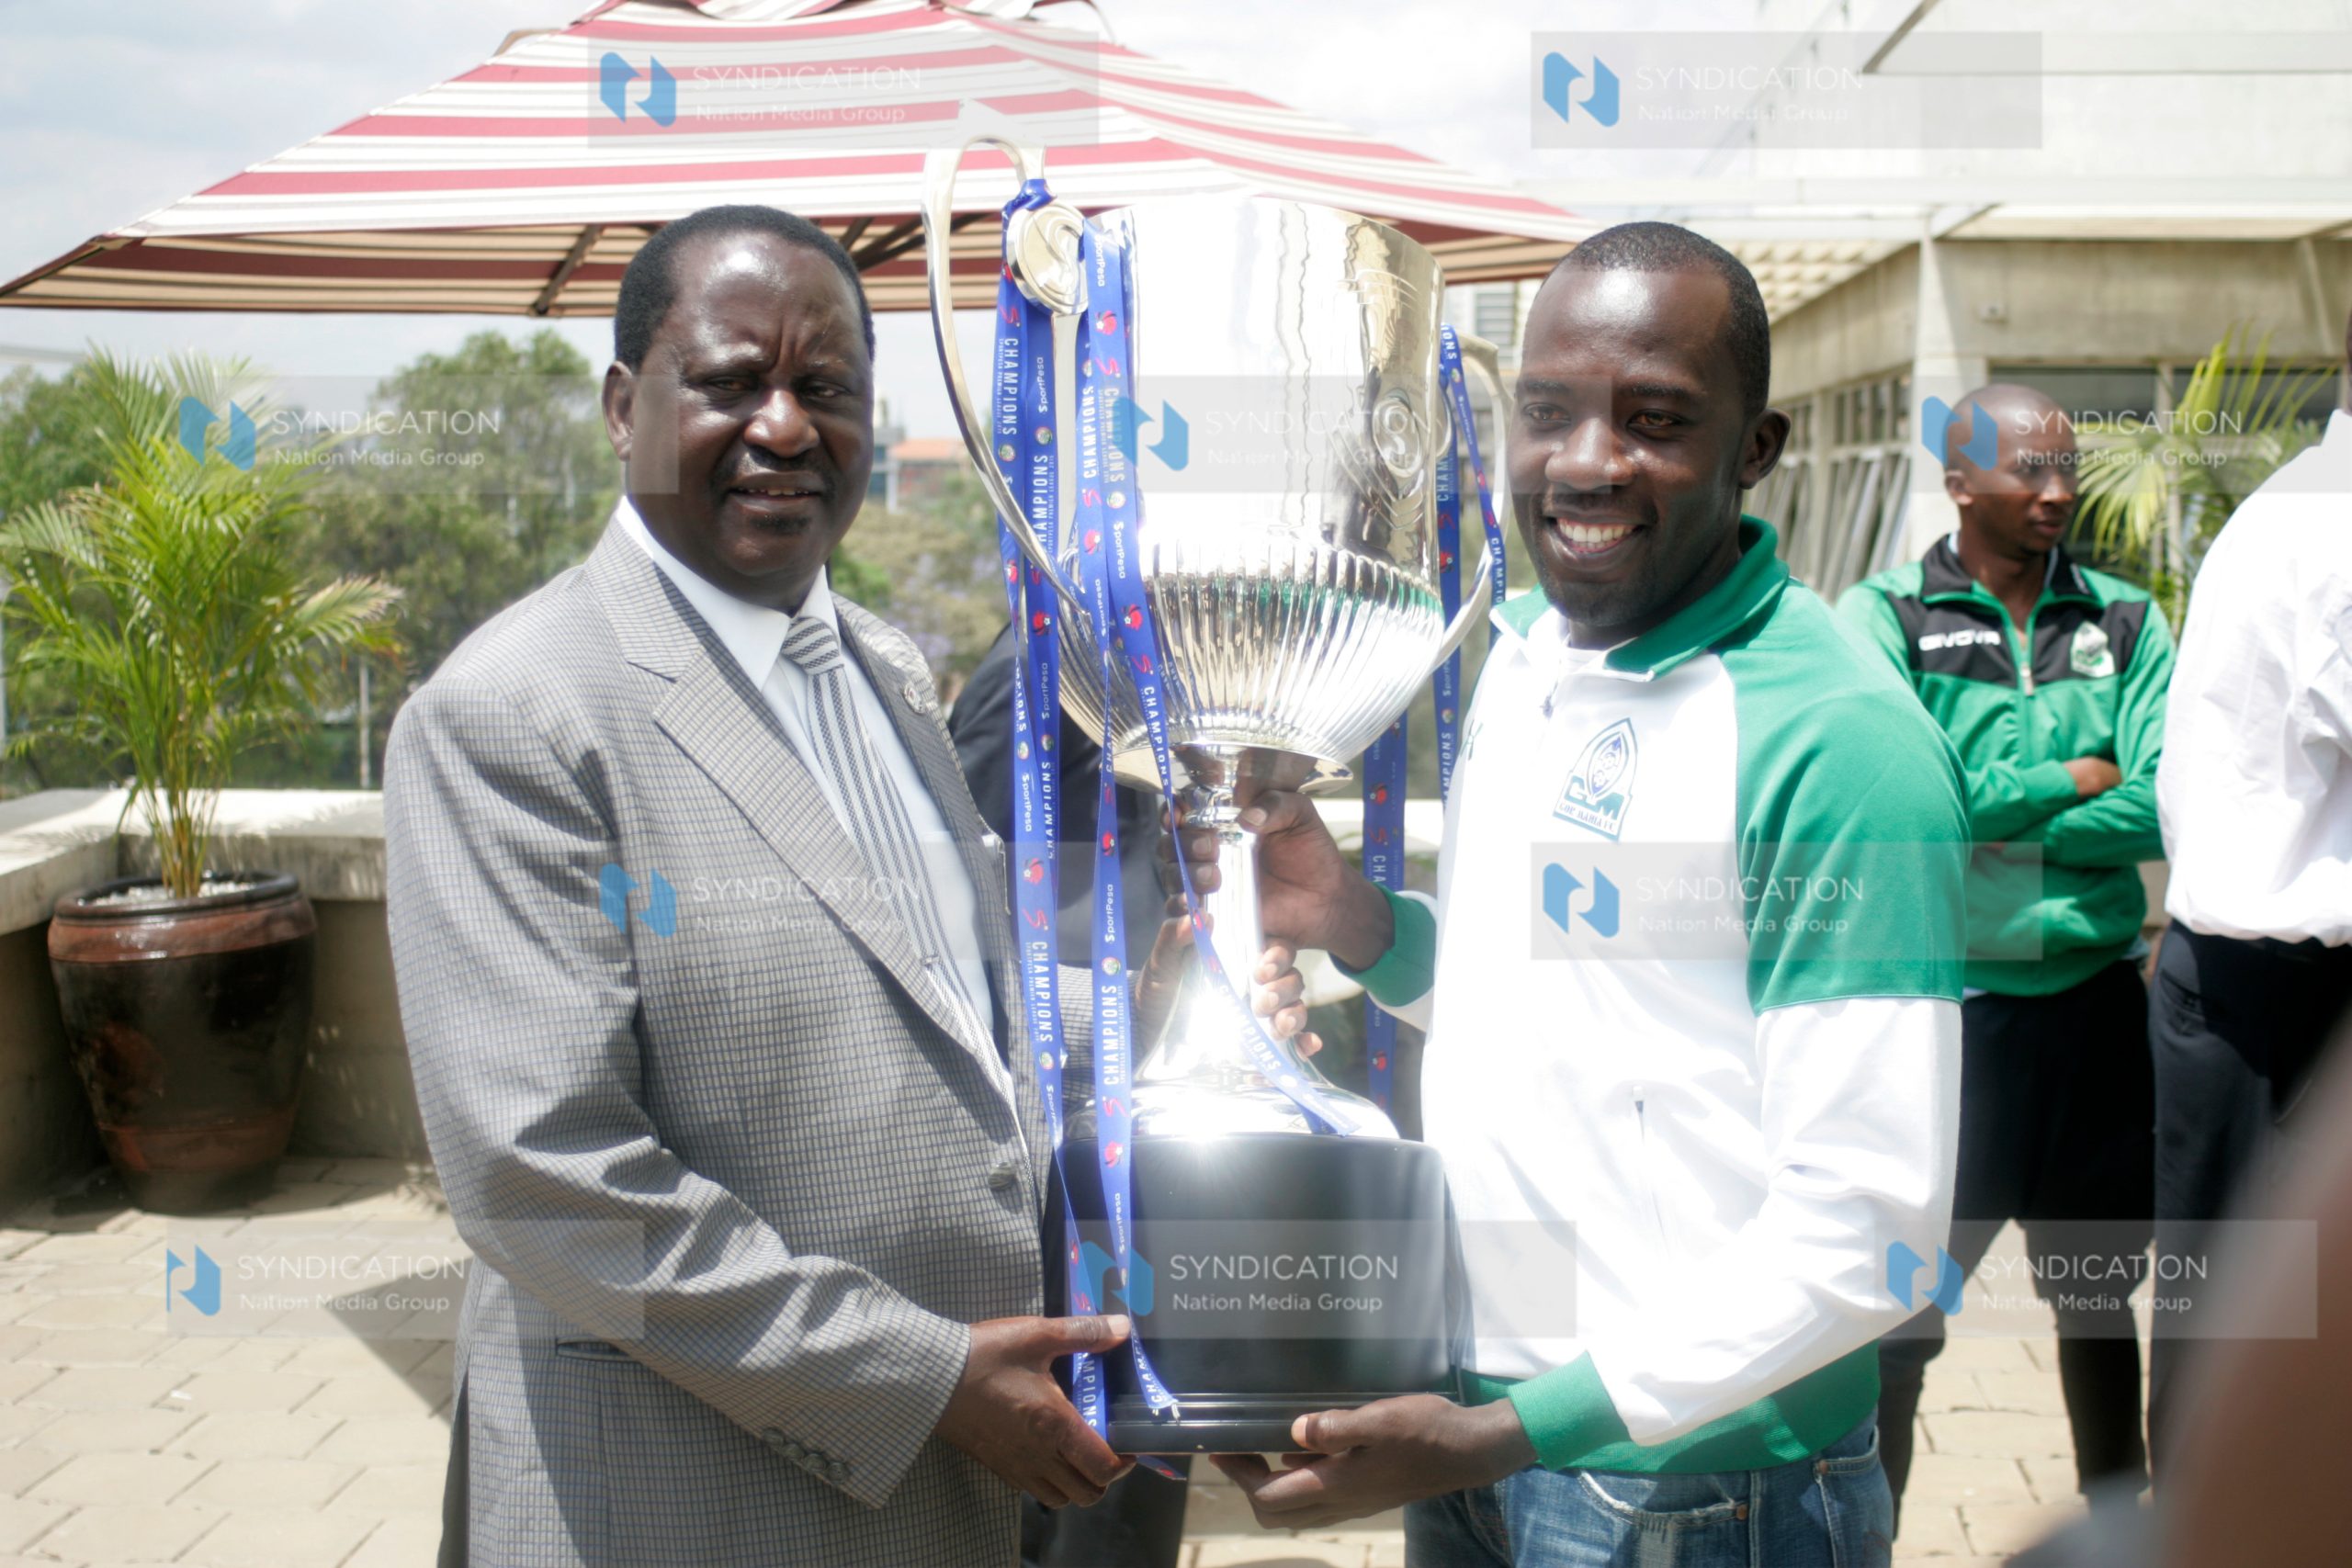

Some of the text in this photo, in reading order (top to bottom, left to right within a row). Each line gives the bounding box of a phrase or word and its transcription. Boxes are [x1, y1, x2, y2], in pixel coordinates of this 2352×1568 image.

[1002, 338, 1019, 434] CHAMPIONS
[1037, 357, 1047, 413] SportPesa
[1082, 386, 1097, 479] CHAMPIONS
[1033, 455, 1048, 542] HAMPIONS
[1114, 521, 1125, 579] SportPesa
[1491, 537, 1505, 603] CHAMPIO
[1041, 662, 1050, 719] SportPesa
[1144, 686, 1169, 786] CHAMPIONS
[1023, 773, 1032, 832] SportPesa
[1104, 884, 1114, 943] SportPesa
[1032, 941, 1053, 1043] CHAMPIONS
[1102, 985, 1119, 1085] CHAMPIONS
[1114, 1192, 1125, 1254] SportPesa
[1082, 1352, 1097, 1427] MPIONS
